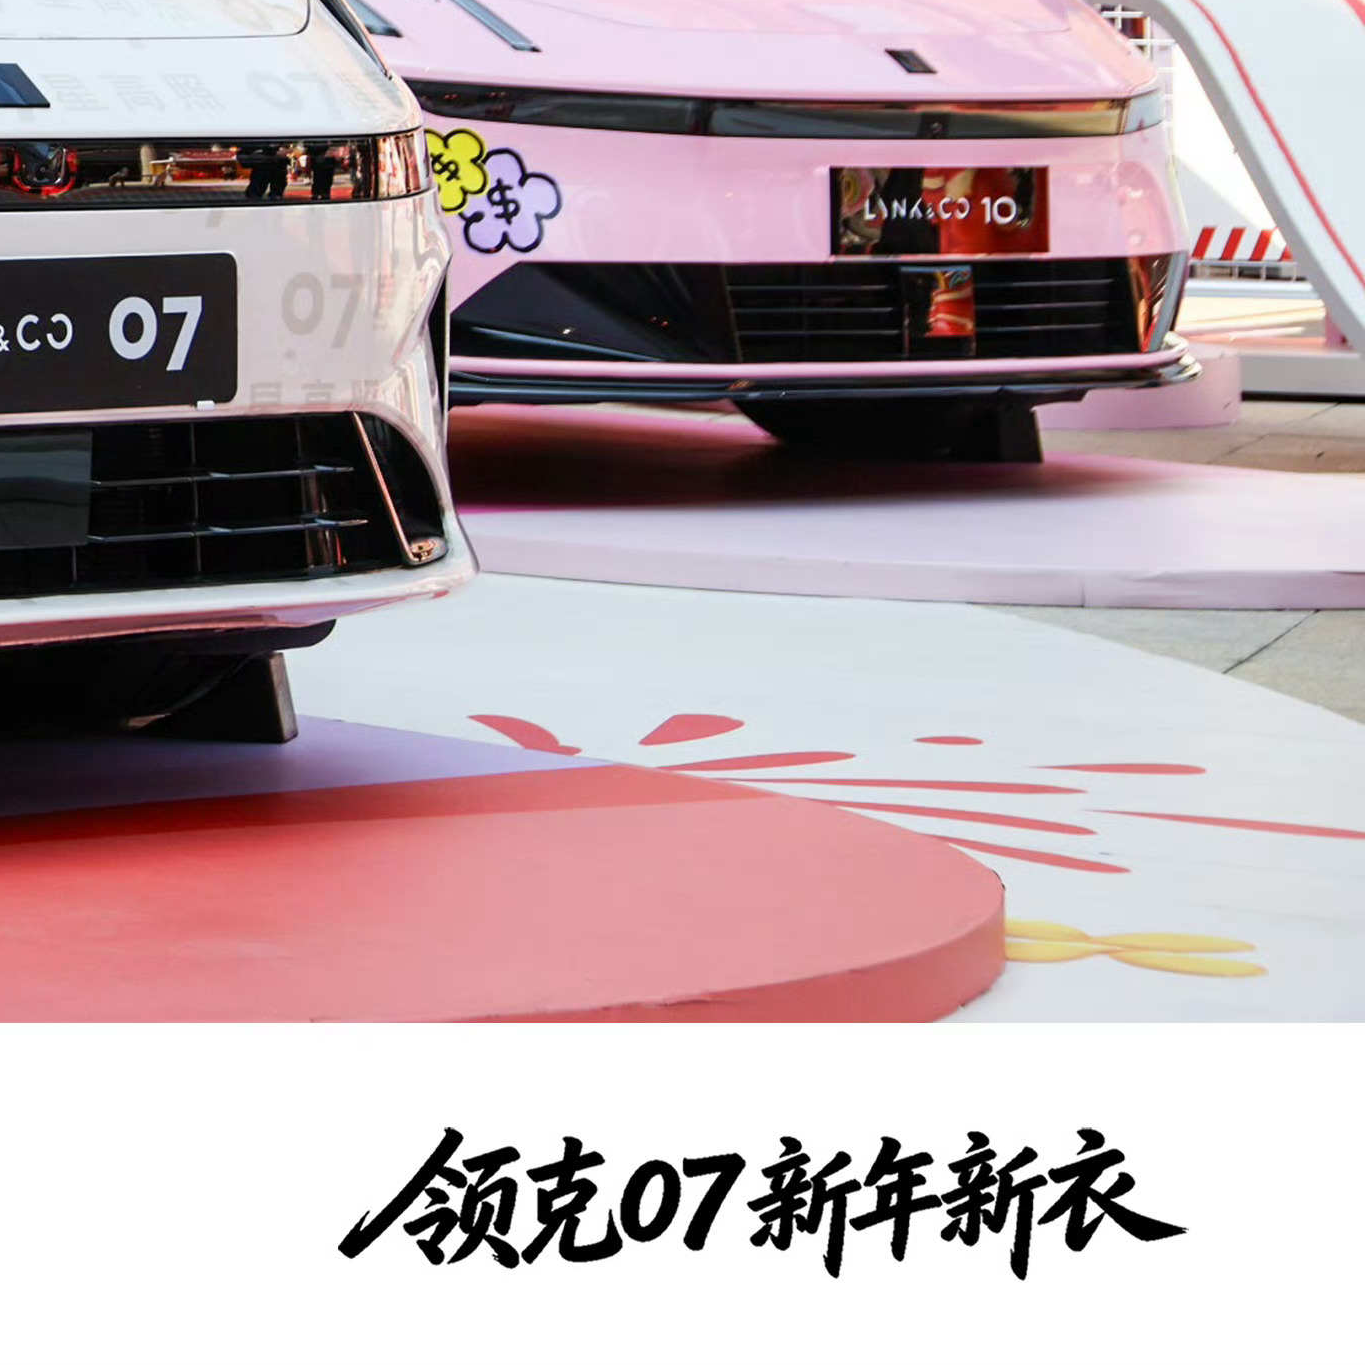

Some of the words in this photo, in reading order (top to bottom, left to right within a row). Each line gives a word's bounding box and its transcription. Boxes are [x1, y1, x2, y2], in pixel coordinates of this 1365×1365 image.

[863, 195, 971, 221] LYNK&CO
[980, 195, 1018, 225] 10
[107, 294, 204, 372] 07
